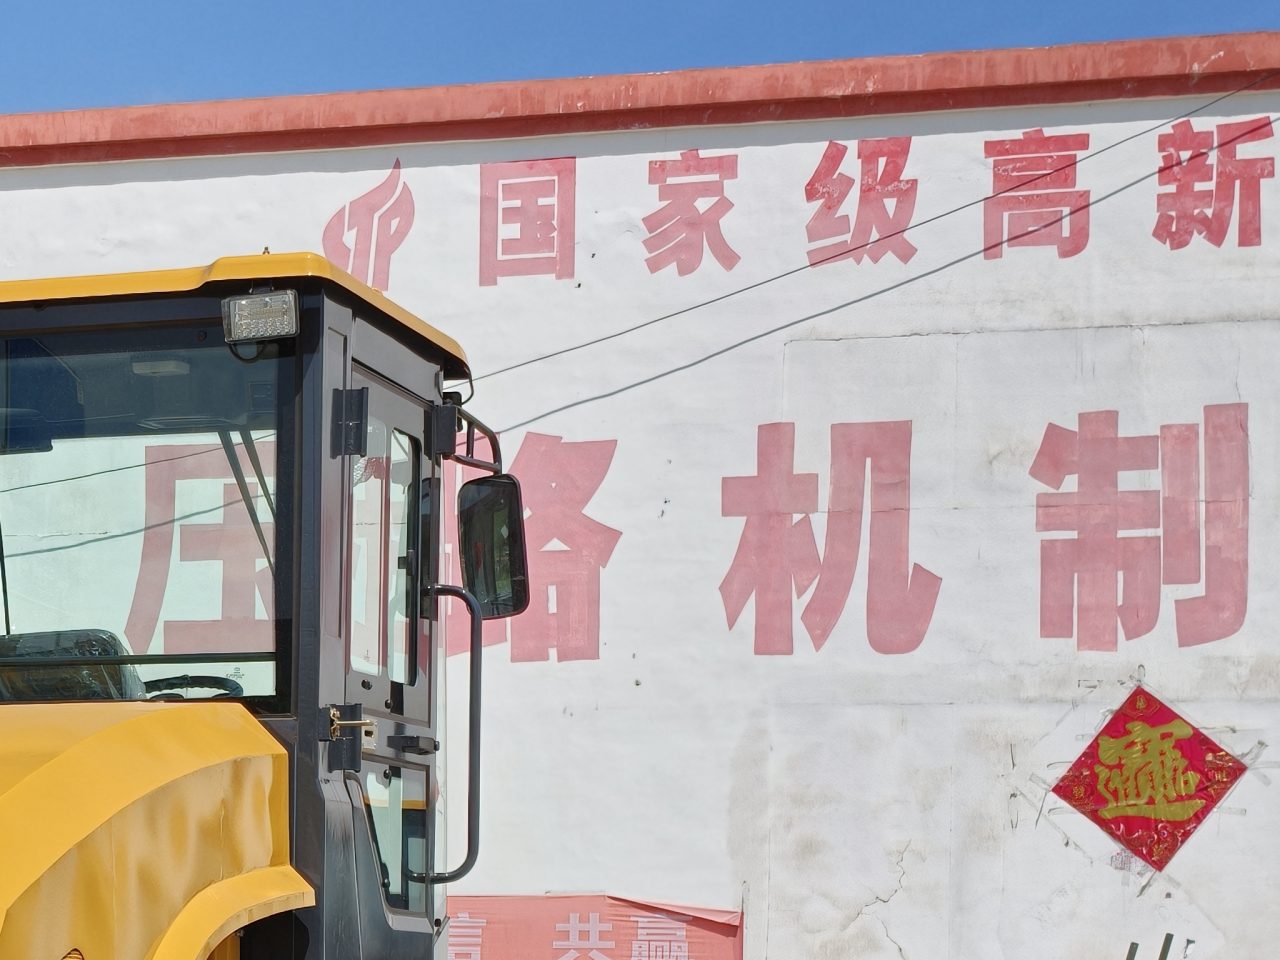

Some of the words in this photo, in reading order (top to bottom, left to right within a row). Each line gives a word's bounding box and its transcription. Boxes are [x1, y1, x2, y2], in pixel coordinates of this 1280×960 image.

[478, 115, 1275, 288] 国家级高新
